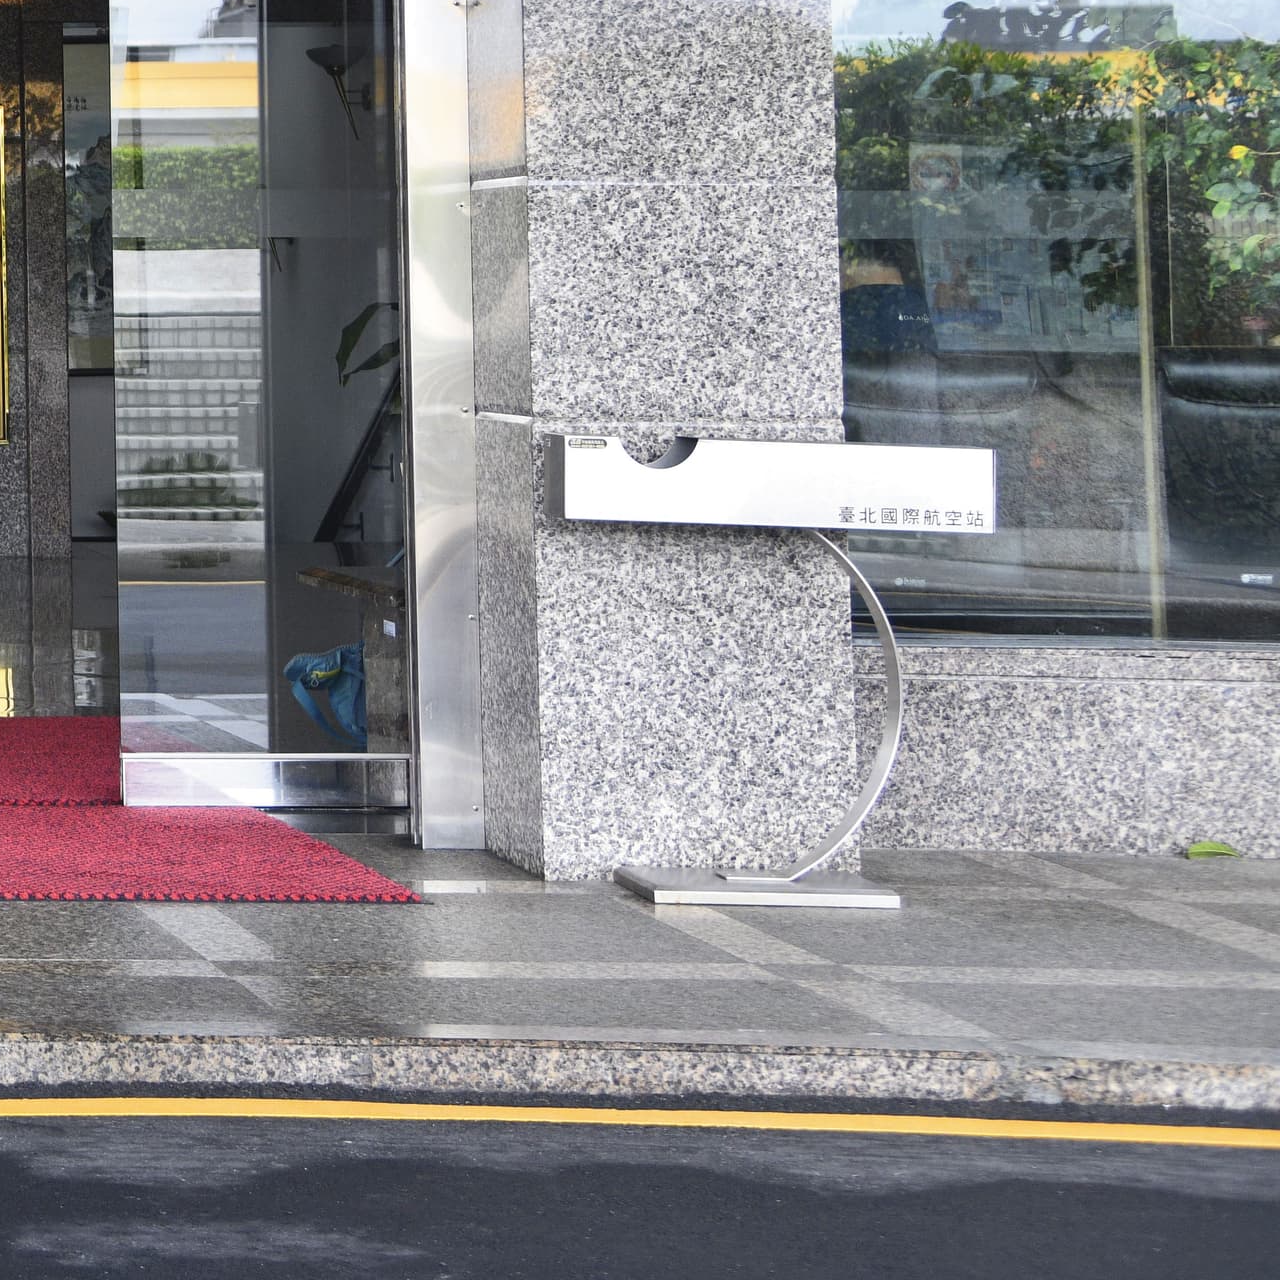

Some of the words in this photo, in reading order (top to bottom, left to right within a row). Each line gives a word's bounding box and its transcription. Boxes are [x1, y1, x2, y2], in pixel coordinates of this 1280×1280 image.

[838, 506, 984, 528] 臺北國際航空站
